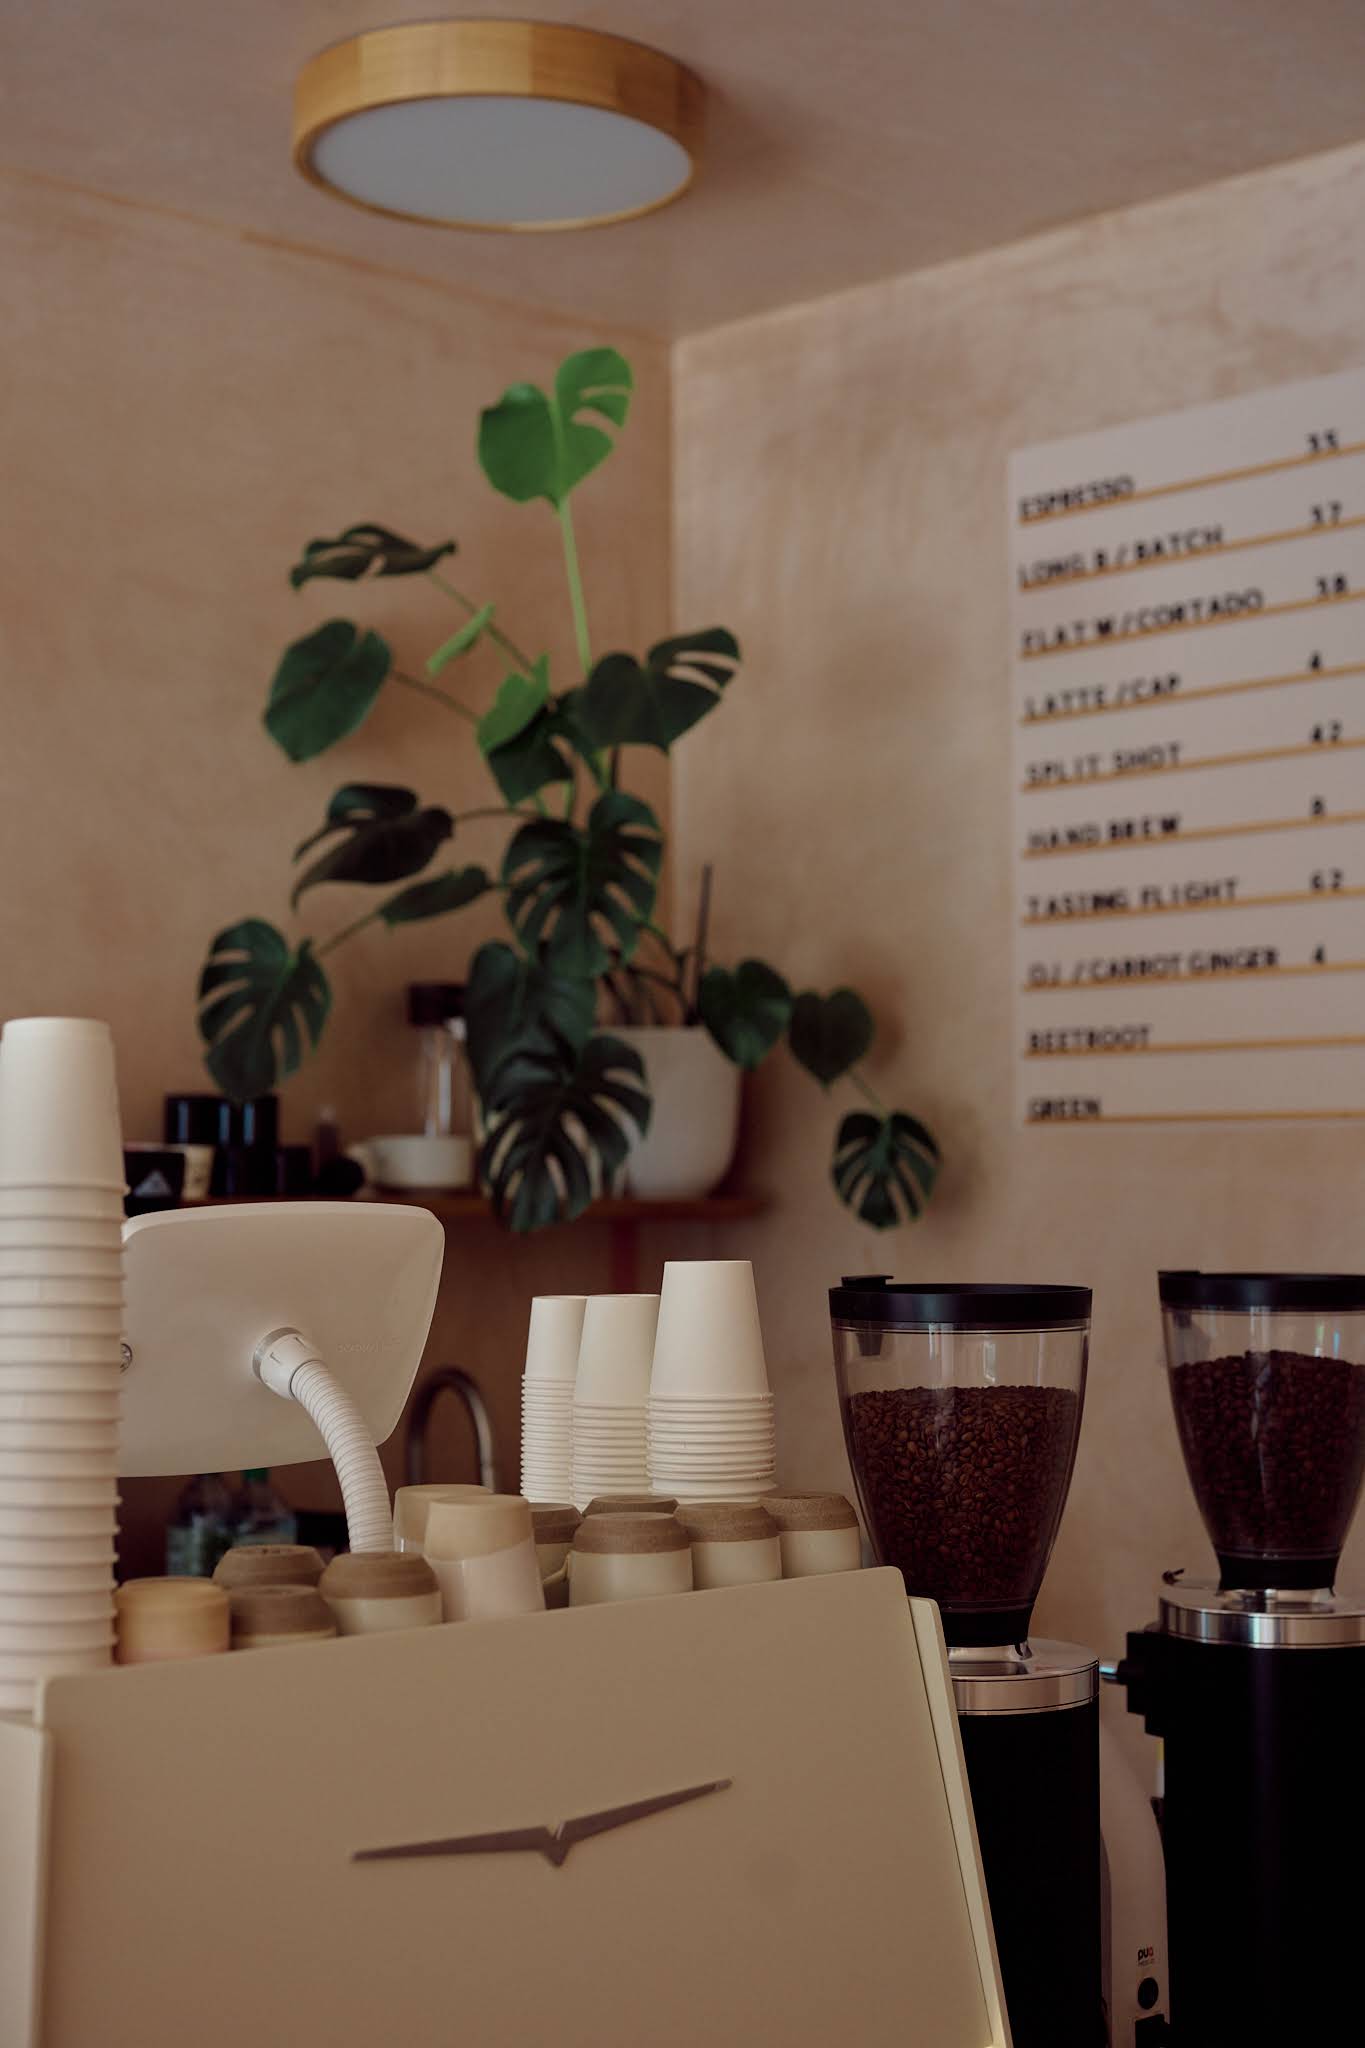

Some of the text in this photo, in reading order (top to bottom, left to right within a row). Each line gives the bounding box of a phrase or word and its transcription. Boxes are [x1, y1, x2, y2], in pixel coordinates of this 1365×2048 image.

[1019, 475, 1134, 519] ESPRESSO
[1018, 553, 1085, 588] LONG
[1023, 621, 1085, 653] FLAT
[1027, 754, 1099, 784] SPLIT
[1113, 741, 1180, 771] SHOT
[1029, 822, 1100, 849] HAND
[1109, 815, 1180, 840] BREW
[1028, 889, 1127, 917] TASTING
[1141, 877, 1238, 907] FLIGHT
[1188, 947, 1277, 972] GINGER
[1030, 1025, 1151, 1051] BEETROOT
[1029, 1098, 1100, 1119] GREEN
